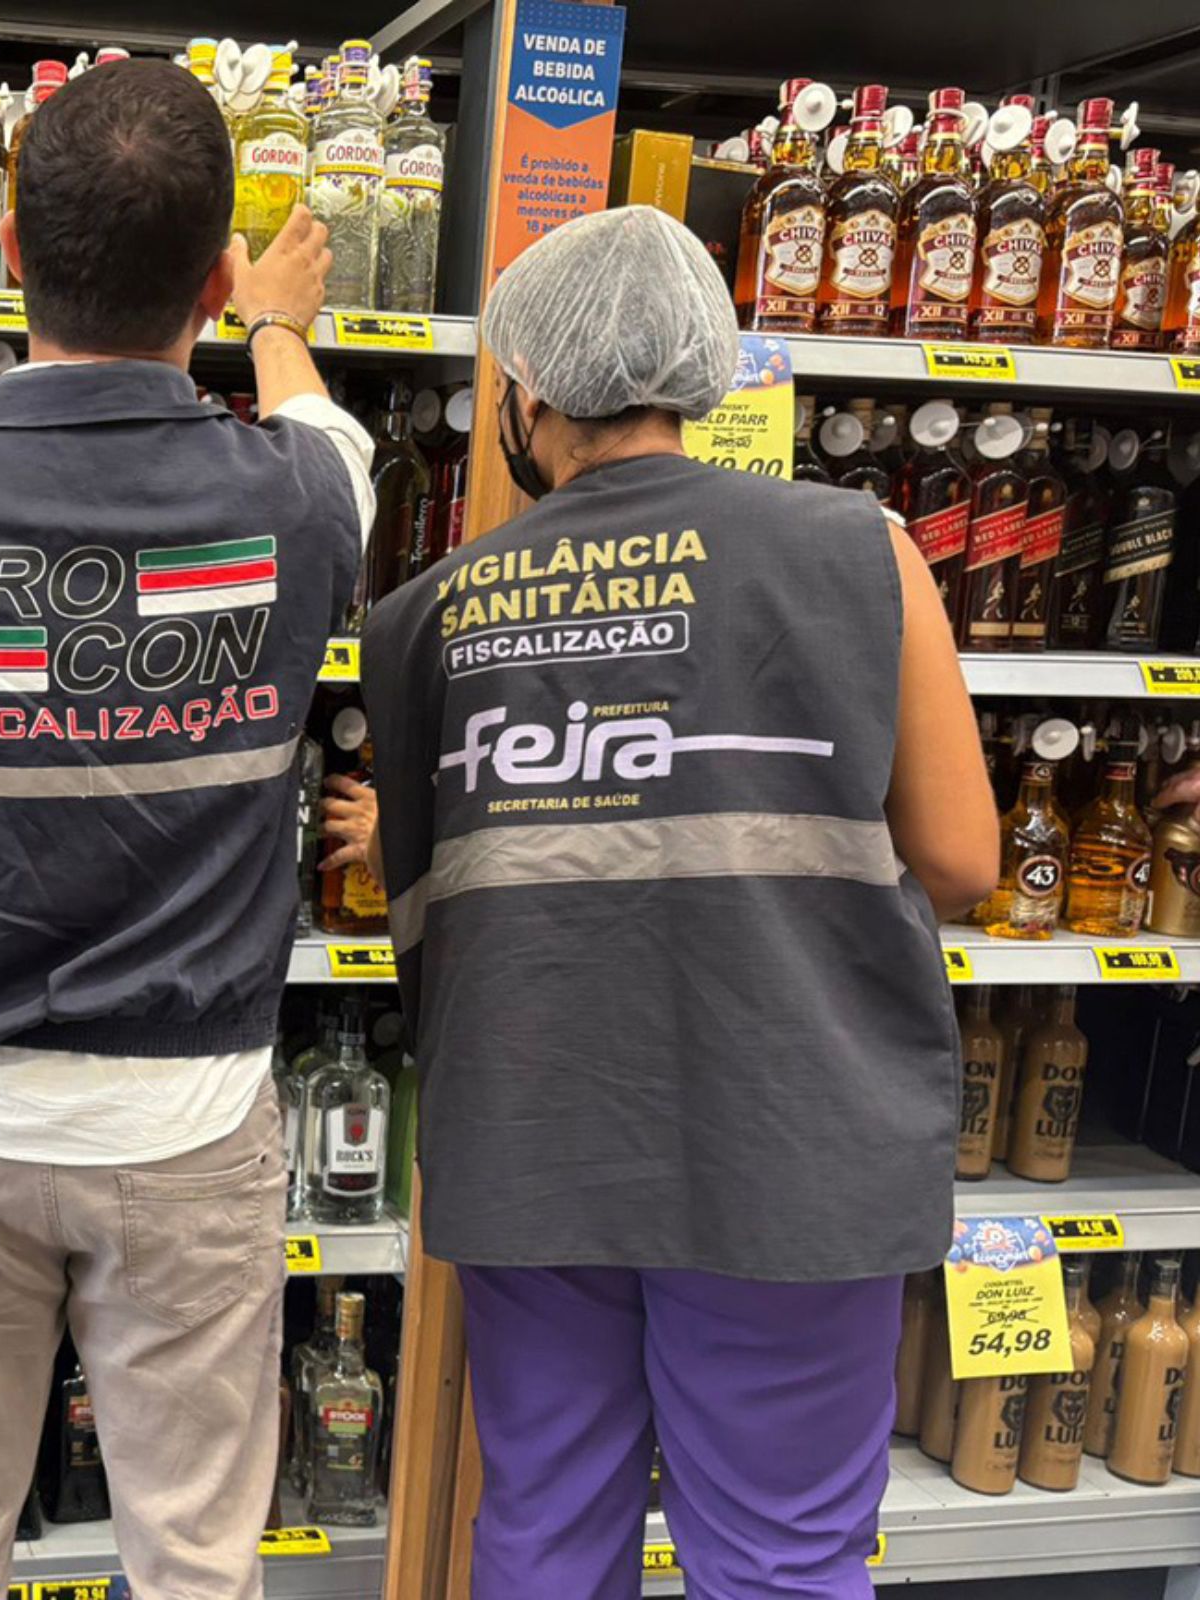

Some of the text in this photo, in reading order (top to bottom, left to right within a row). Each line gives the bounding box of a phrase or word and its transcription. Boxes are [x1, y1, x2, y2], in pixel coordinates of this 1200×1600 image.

[523, 33, 606, 56] VENDA DE
[532, 60, 595, 81] BEBIDA
[251, 146, 303, 166] GORDON
[326, 144, 383, 162] GORDON
[531, 157, 579, 172] proibido
[504, 173, 604, 190] venda de bebidas
[518, 205, 567, 219] menores
[779, 226, 823, 243] CHIVA
[934, 232, 975, 248] CHIVA
[707, 413, 768, 426] LD PARR
[436, 529, 708, 600] VIGILÂNCIA
[440, 572, 696, 638] SANITÁRIA
[53, 607, 270, 695] CON
[451, 620, 674, 670] FISCALIZAÇÃO
[592, 700, 670, 718] PREFEITURA
[487, 793, 640, 814] SECRETARIA DE SAÚDE
[1025, 865, 1055, 886] 43
[963, 1060, 997, 1079] ON
[960, 1119, 989, 1136] UIZ
[976, 1286, 1035, 1300] DON LUIZ
[968, 1328, 1052, 1358] 54,98
